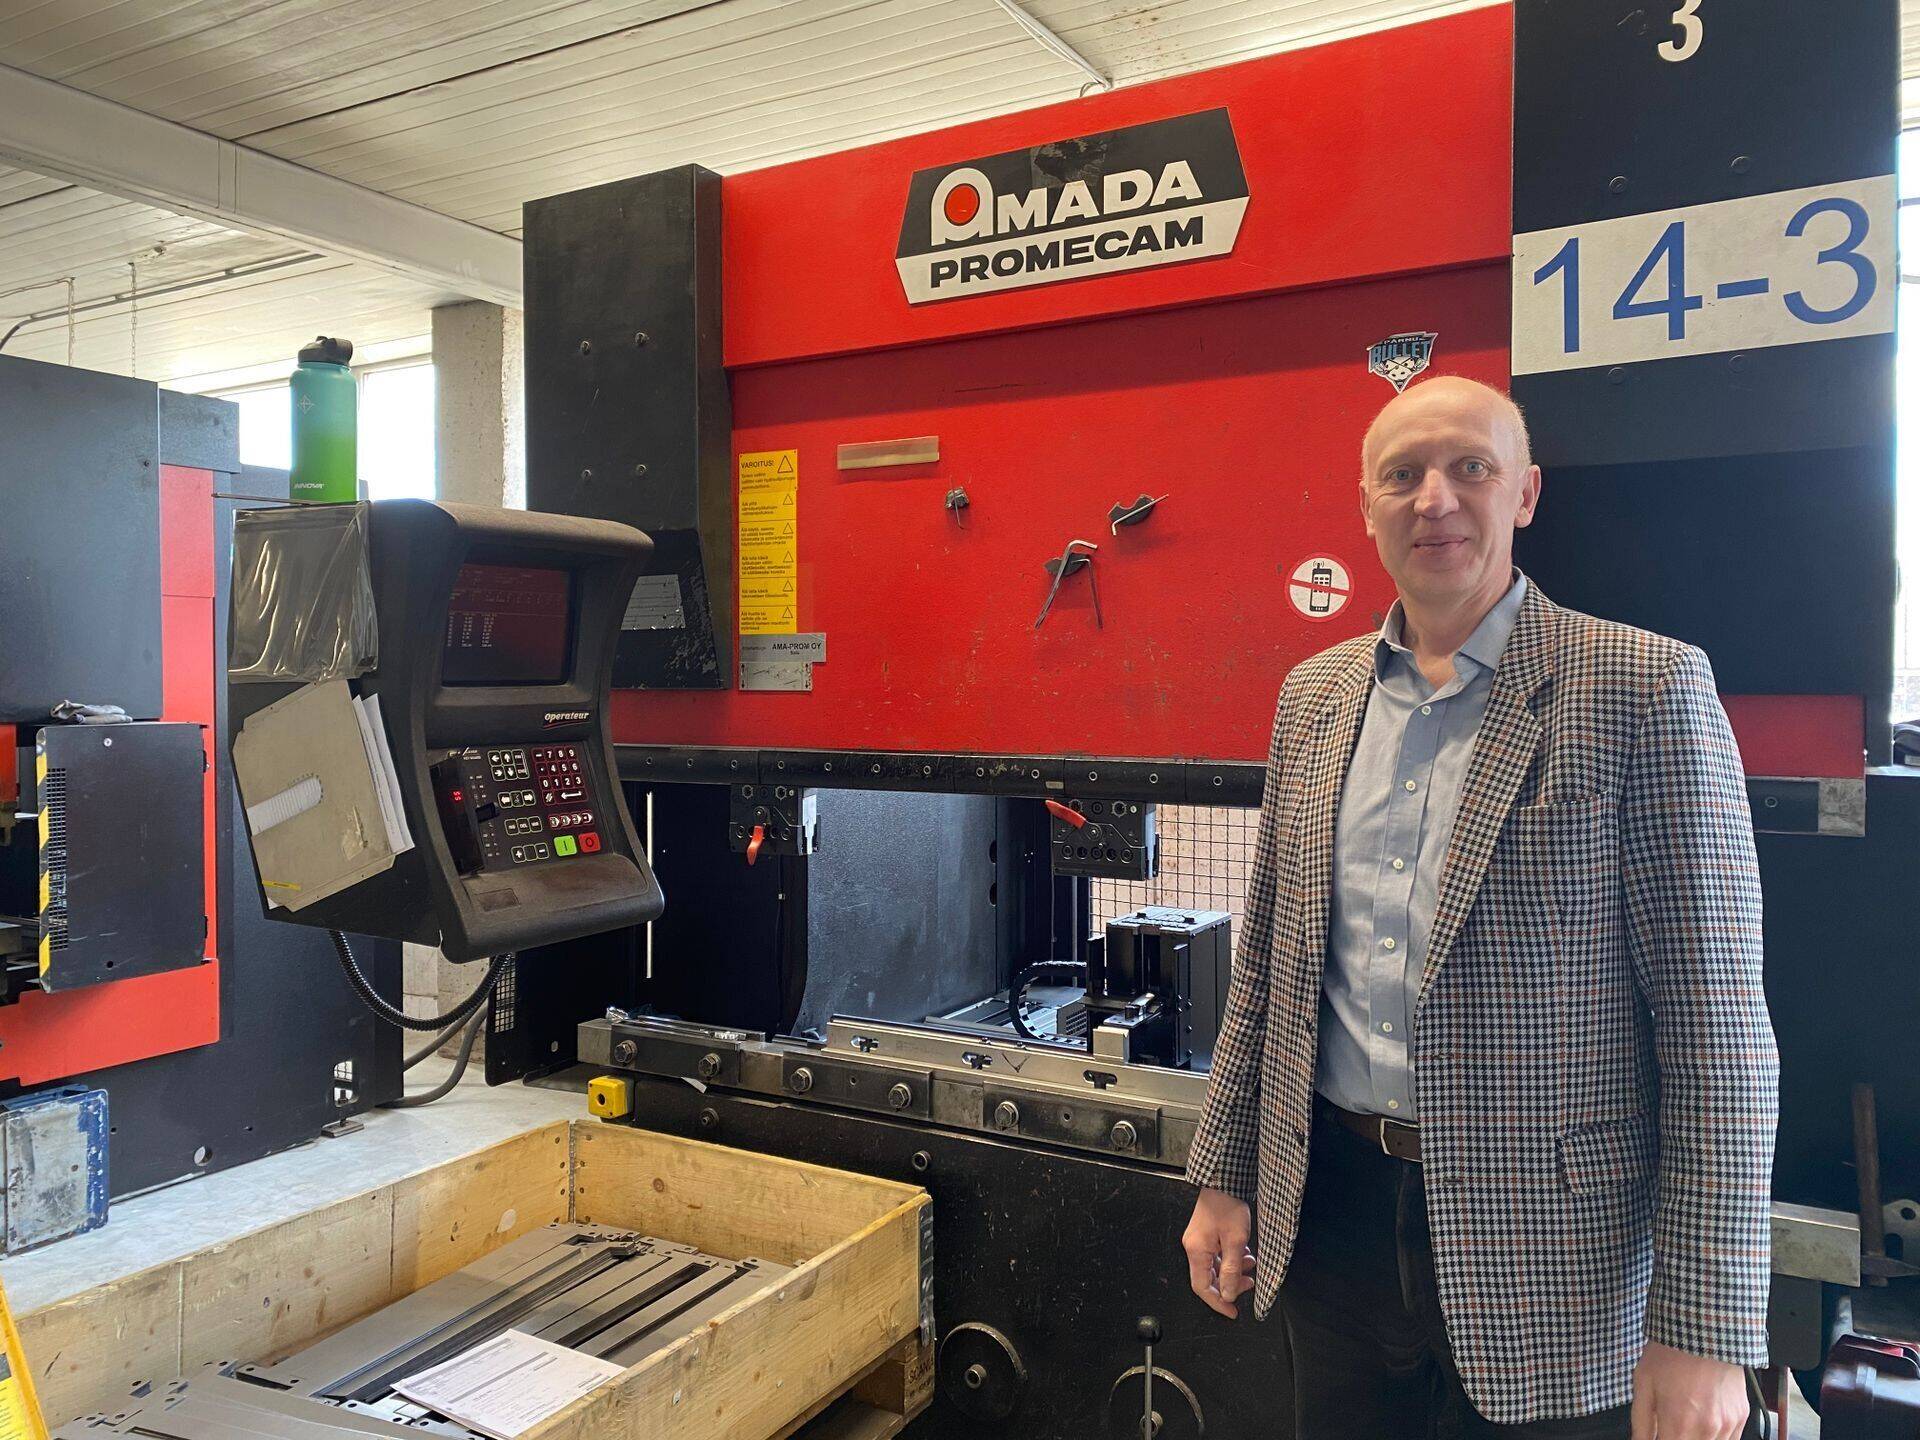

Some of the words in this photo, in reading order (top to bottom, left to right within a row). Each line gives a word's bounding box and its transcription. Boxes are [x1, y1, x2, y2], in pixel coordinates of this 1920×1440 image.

[1657, 0, 1703, 62] 3
[931, 160, 1203, 247] AMADA
[930, 215, 1204, 289] PROMECAM
[1534, 197, 1877, 353] 14-3
